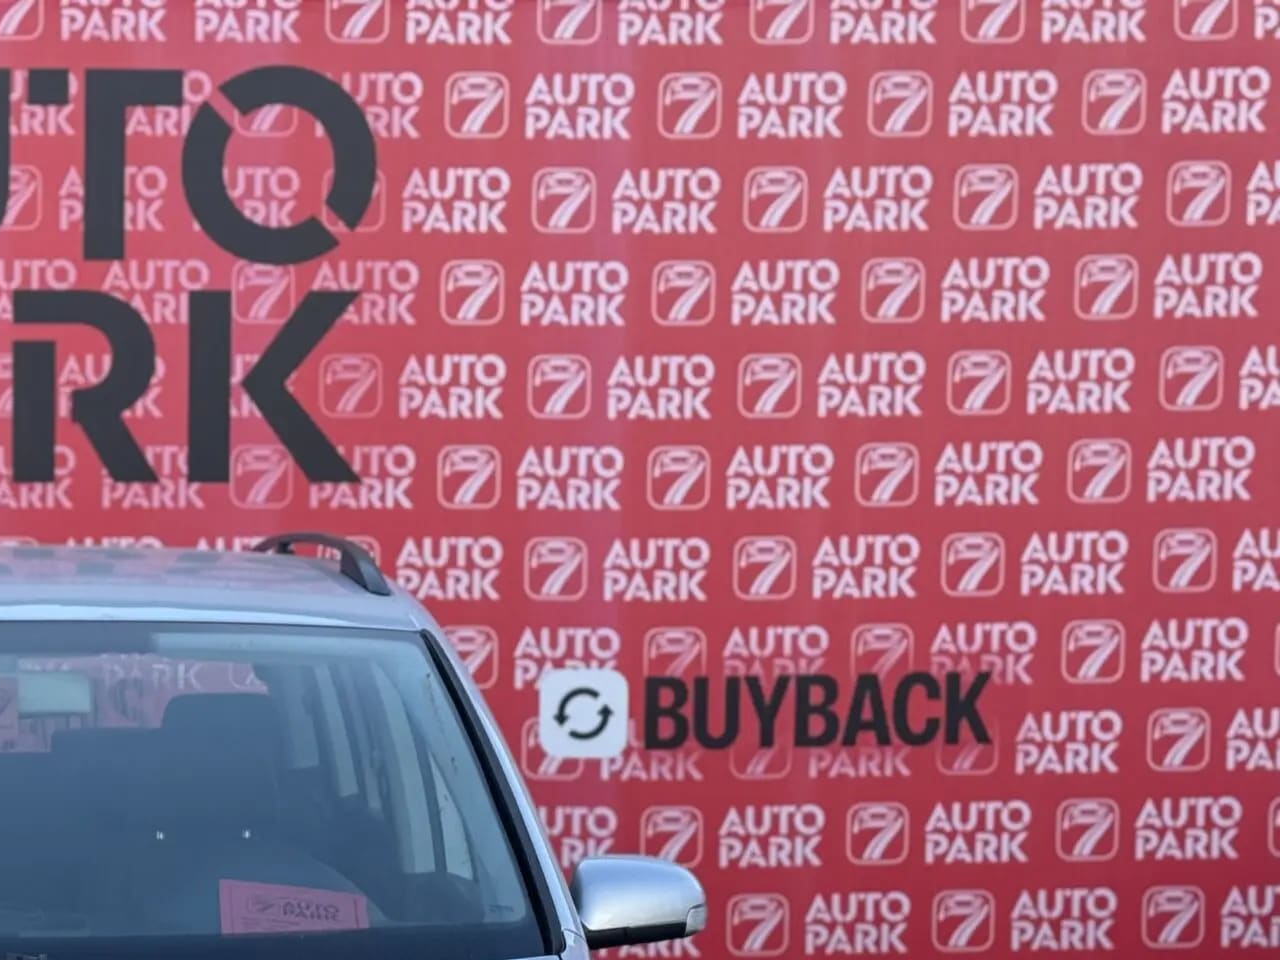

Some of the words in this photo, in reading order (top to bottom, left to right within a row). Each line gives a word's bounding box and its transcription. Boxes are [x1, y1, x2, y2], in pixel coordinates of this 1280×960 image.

[61, 7, 165, 41] PARK
[406, 10, 511, 44] PARK
[830, 10, 936, 44] PARK
[525, 73, 635, 106] AUTO
[738, 72, 847, 105] AUTO
[949, 70, 1058, 104] AUTO
[1162, 66, 1270, 101] AUTO
[525, 105, 630, 139] PARK
[738, 104, 842, 138] PARK
[948, 102, 1053, 137] PARK
[1162, 99, 1266, 134] PARK
[403, 167, 511, 200] AUTO
[824, 165, 933, 199] AUTO
[1034, 163, 1143, 197] AUTO
[403, 200, 506, 233] PARK
[824, 197, 928, 232] PARK
[1034, 195, 1138, 229] PARK
[101, 260, 209, 290] AUTO
[312, 260, 419, 292] AUTO
[521, 261, 629, 294] AUTO
[731, 259, 840, 293] AUTO
[941, 256, 1050, 289] AUTO
[1154, 252, 1262, 286] AUTO
[520, 292, 624, 326] PARK
[731, 291, 835, 325] PARK
[941, 288, 1045, 322] PARK
[1154, 283, 1258, 318] PARK
[400, 354, 506, 387] AUTO
[608, 354, 715, 387] AUTO
[1027, 348, 1135, 381] AUTO
[399, 385, 502, 419] PARK
[607, 386, 710, 420] PARK
[1027, 380, 1131, 414] PARK
[517, 446, 624, 478] AUTO
[726, 444, 834, 478] AUTO
[935, 440, 1043, 473] AUTO
[1147, 436, 1255, 470] AUTO
[517, 477, 620, 510] PARK
[726, 476, 830, 509] PARK
[935, 472, 1039, 506] PARK
[1147, 467, 1251, 502] PARK
[396, 536, 504, 568] AUTO
[604, 537, 710, 570] AUTO
[812, 534, 920, 567] AUTO
[1021, 530, 1128, 563] AUTO
[396, 567, 500, 600] PARK
[604, 570, 706, 602] PARK
[812, 565, 916, 599] PARK
[1021, 562, 1124, 596] PARK
[514, 627, 620, 659] AUTO
[723, 625, 829, 657] AUTO
[931, 621, 1037, 654] AUTO
[1141, 617, 1248, 651] AUTO
[1141, 649, 1244, 682] PARK
[643, 671, 991, 750] BUYBACK
[1016, 710, 1122, 742] AUTO
[808, 748, 911, 778] PARK
[1015, 741, 1118, 774] PARK
[719, 804, 825, 837] AUTO
[1135, 796, 1242, 829] AUTO
[719, 835, 821, 868] PARK
[1135, 827, 1238, 860] PARK
[805, 891, 911, 924] AUTO
[1011, 887, 1117, 920] AUTO
[805, 922, 907, 954] PARK
[1011, 918, 1114, 951] PARK
